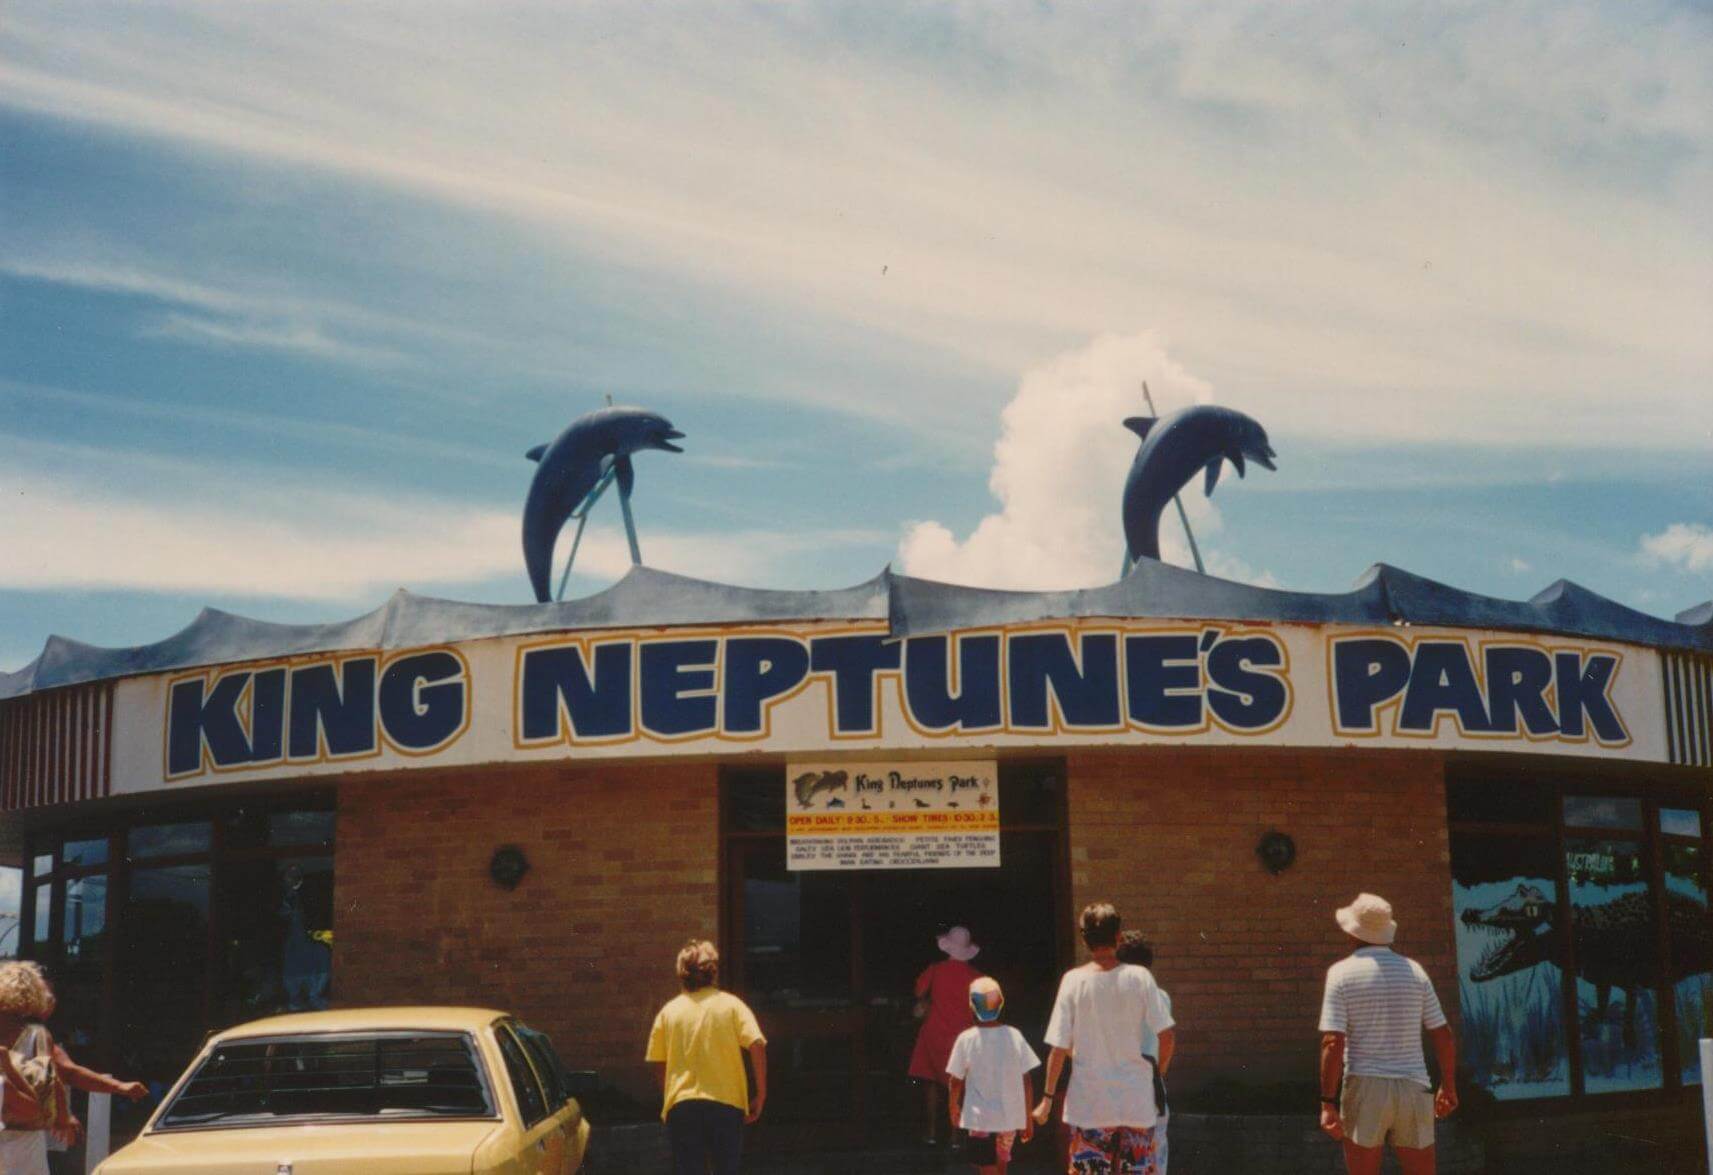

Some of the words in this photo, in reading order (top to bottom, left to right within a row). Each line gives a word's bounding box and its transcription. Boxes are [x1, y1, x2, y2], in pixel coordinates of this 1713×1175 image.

[166, 648, 470, 779] KING
[515, 627, 1291, 743] NEPTUNE'S
[1328, 634, 1632, 746] PARK
[854, 774, 884, 792] King
[948, 775, 980, 792] Park
[788, 815, 812, 825] OPEN
[892, 813, 919, 824] SHOW
